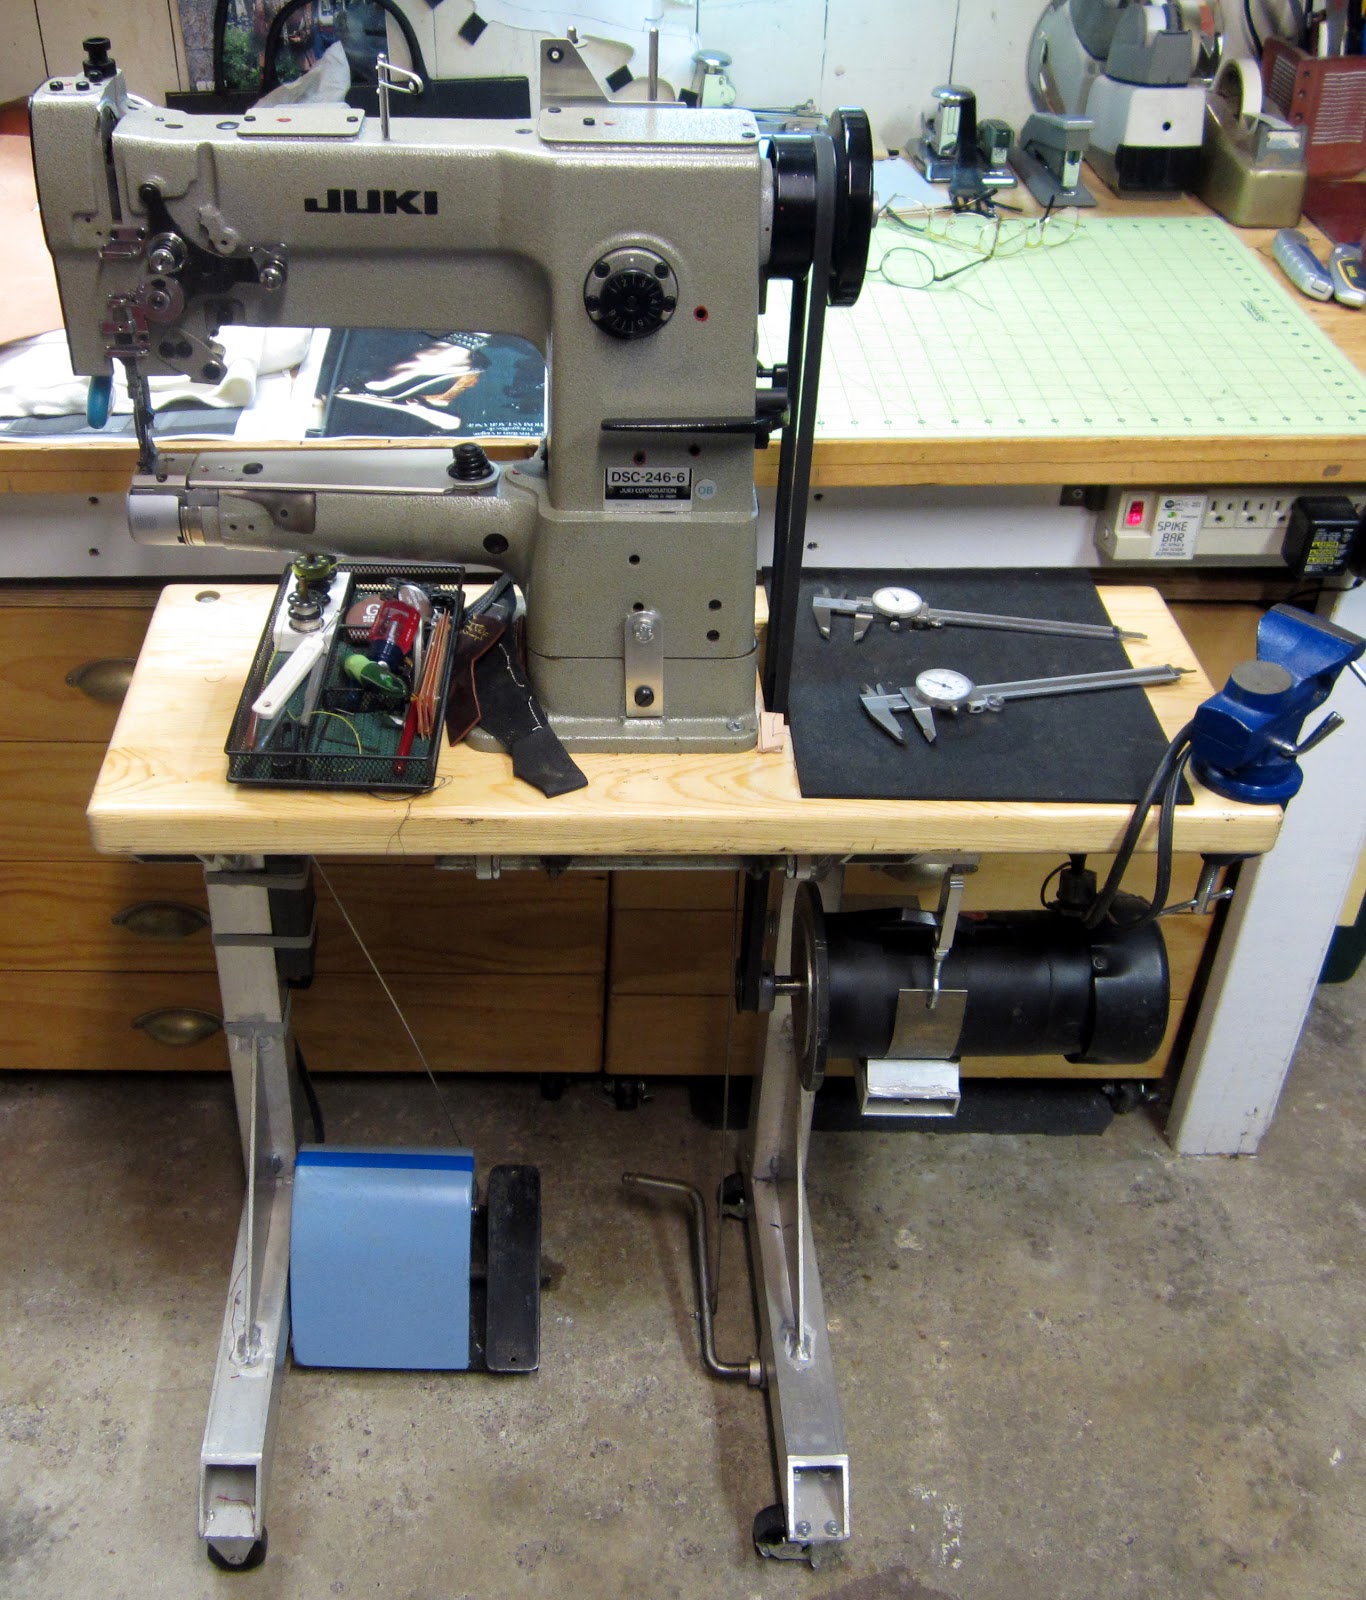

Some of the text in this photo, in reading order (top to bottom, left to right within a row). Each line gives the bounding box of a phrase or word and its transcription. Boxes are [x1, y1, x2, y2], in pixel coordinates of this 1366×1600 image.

[304, 189, 438, 214] JUKI
[611, 471, 686, 483] DSC-246-6
[698, 485, 714, 496] OB
[1157, 521, 1189, 532] SPIKE
[1162, 533, 1185, 543] BAR
[365, 603, 381, 616] G
